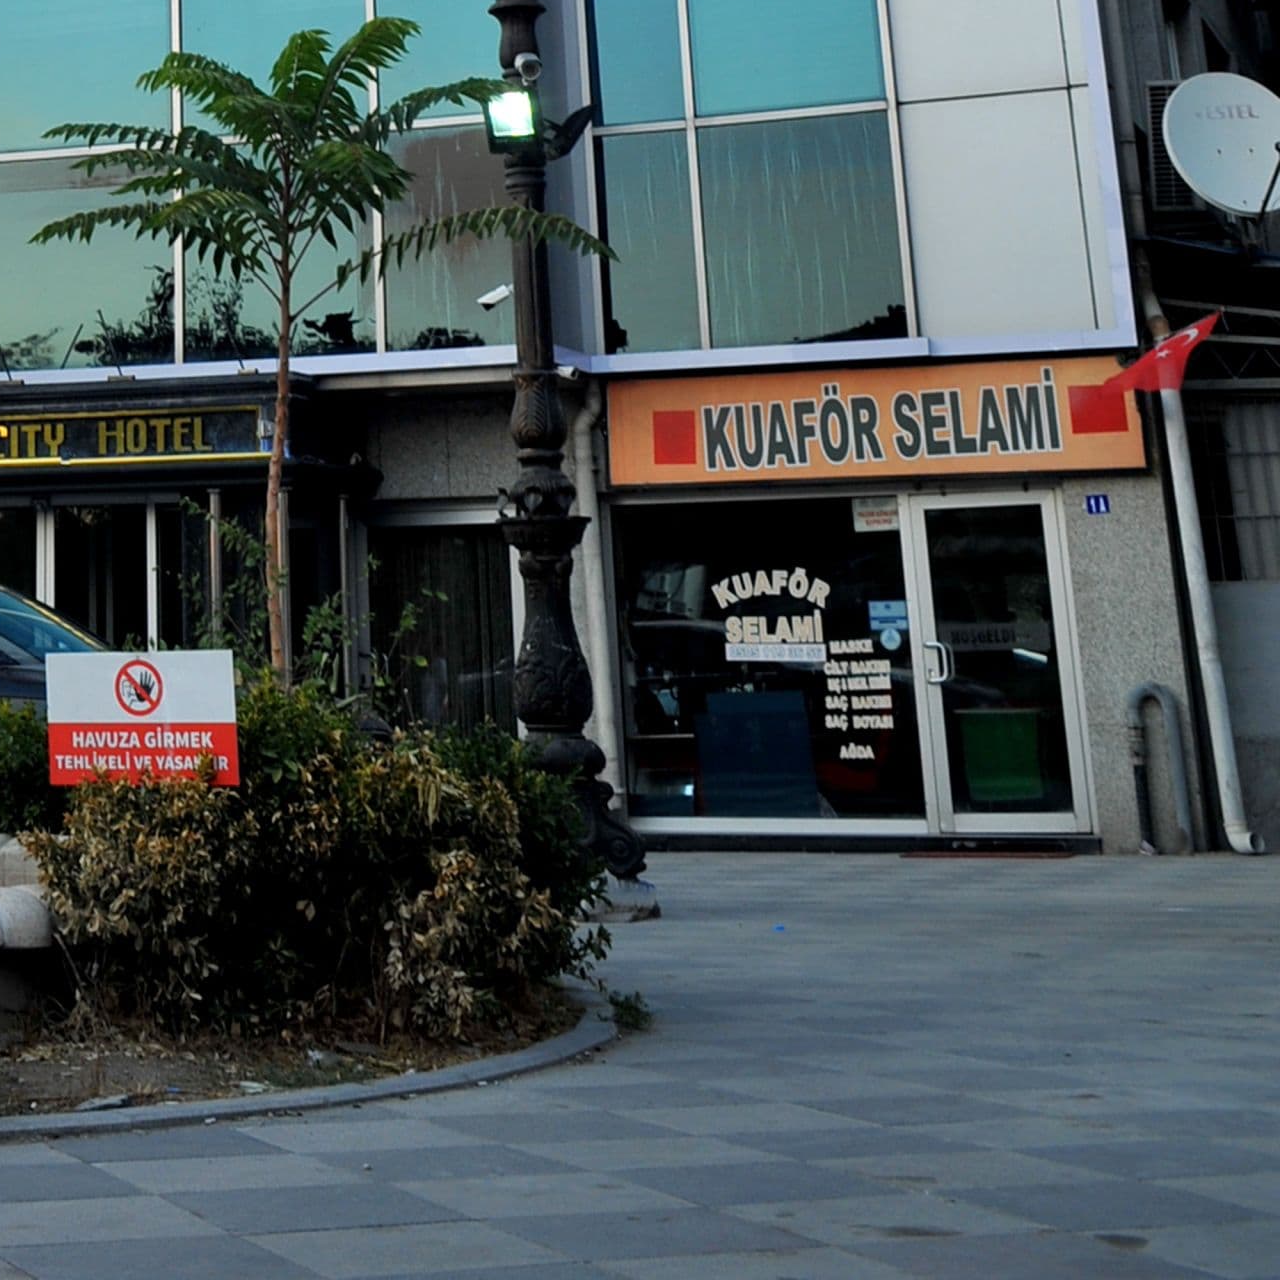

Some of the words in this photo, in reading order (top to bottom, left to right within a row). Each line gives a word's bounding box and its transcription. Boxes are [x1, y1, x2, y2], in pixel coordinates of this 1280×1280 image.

[98, 416, 213, 456] HOTEL
[701, 383, 886, 472] KUAFÖR
[893, 367, 1063, 460] SELAMİ
[711, 567, 831, 610] KUAFÖR
[725, 609, 824, 644] SELAMİ
[71, 731, 141, 749] HAVUZA
[144, 727, 214, 749] GİRMEK
[55, 751, 131, 771] TEHLİKELİ
[134, 755, 153, 770] VE
[155, 755, 229, 771] YASAKIR
